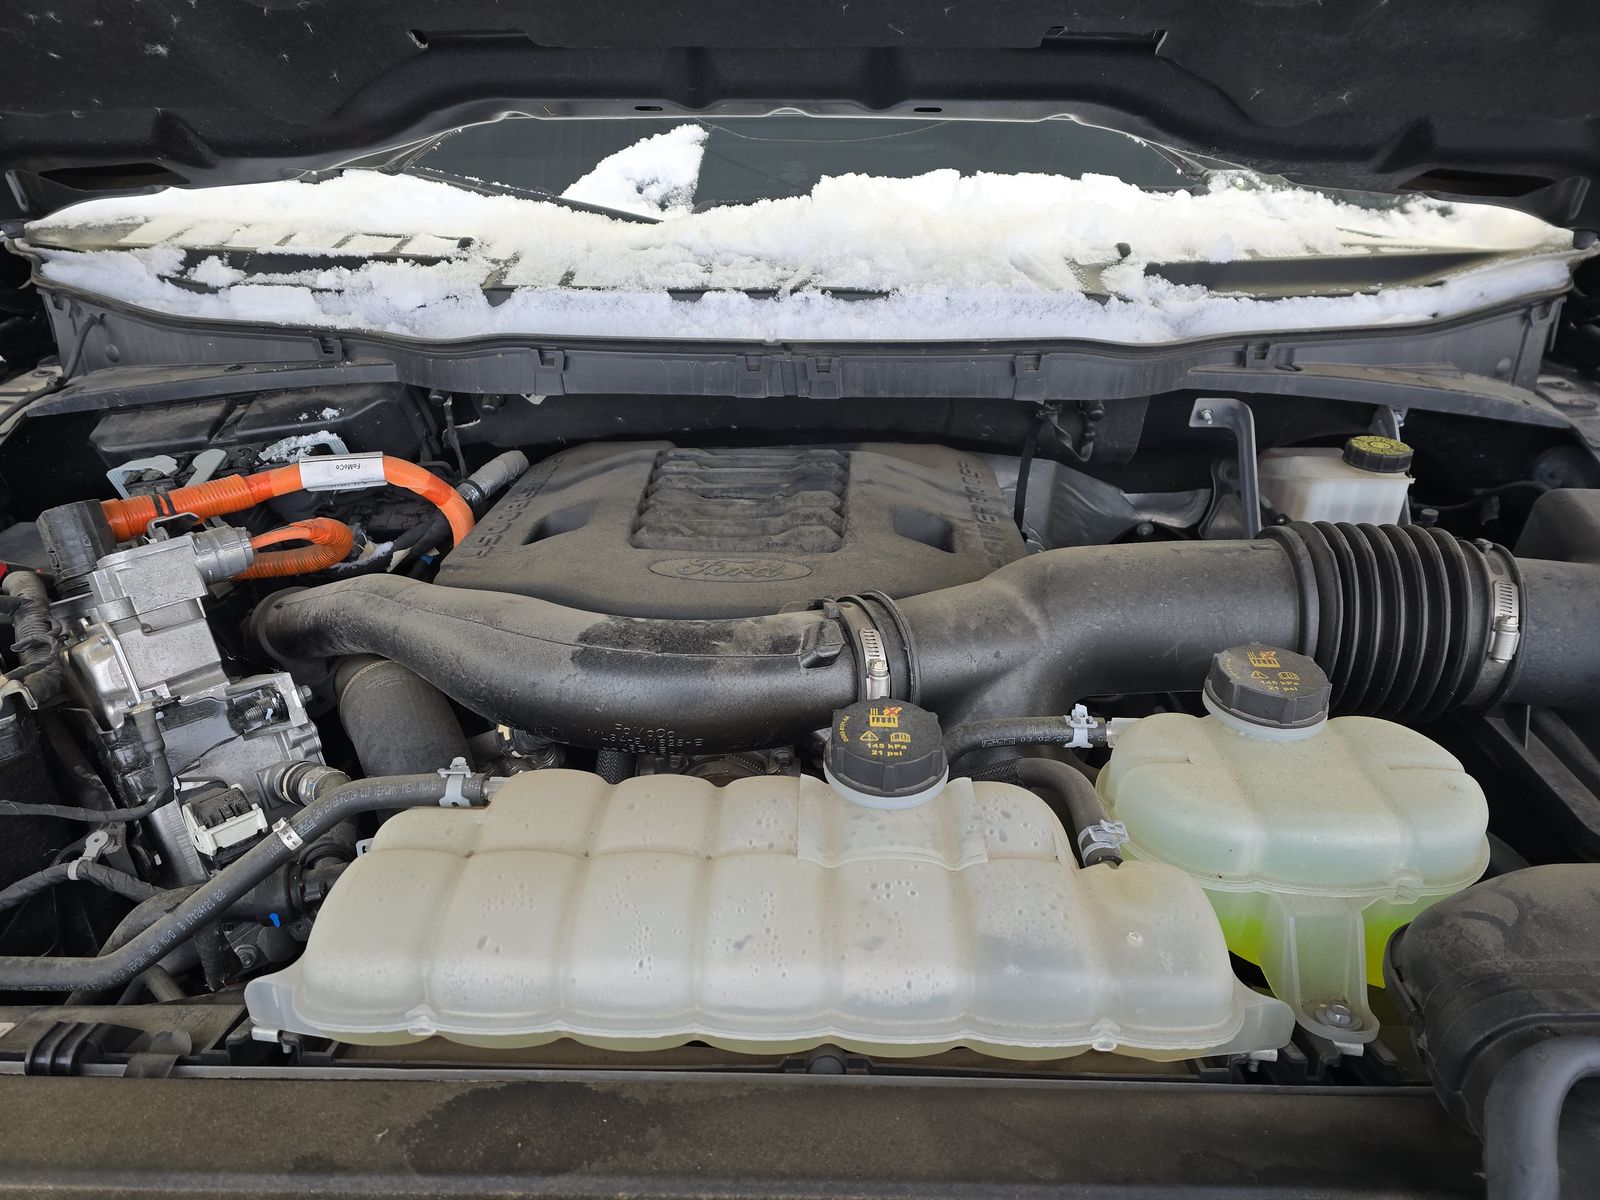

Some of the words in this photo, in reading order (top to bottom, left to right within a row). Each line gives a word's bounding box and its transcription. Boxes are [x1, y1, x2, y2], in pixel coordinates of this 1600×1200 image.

[336, 463, 361, 471] FoMoCo
[677, 559, 785, 578] Ford
[1020, 735, 1069, 743] 03/02/23
